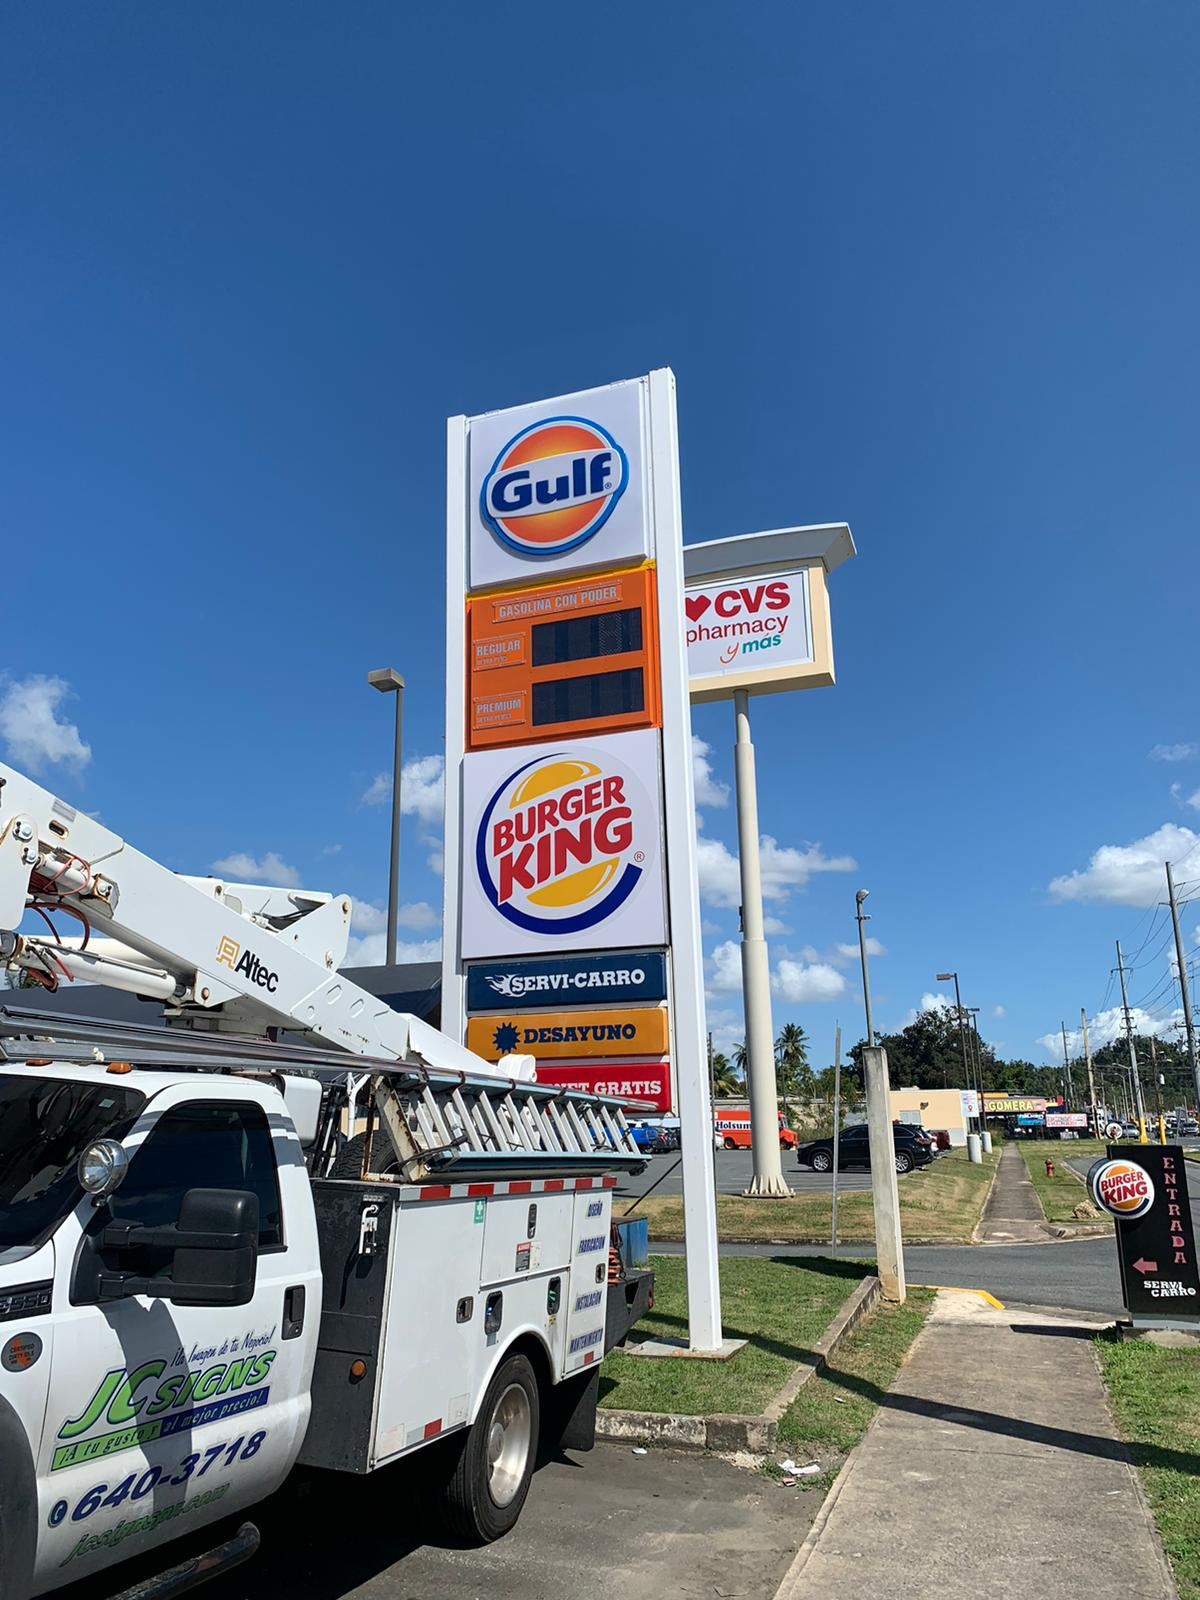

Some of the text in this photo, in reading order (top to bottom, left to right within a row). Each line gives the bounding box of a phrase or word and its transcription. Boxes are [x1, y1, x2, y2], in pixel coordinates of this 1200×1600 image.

[491, 452, 612, 512] Gulf
[499, 586, 617, 617] GASOLINA CON PODER
[714, 581, 791, 618] CVS
[686, 615, 789, 647] pharmacy
[476, 639, 521, 656] REGULAR
[719, 633, 782, 664] y más
[476, 699, 521, 713] PREMIUM
[493, 775, 626, 858] BURGER
[498, 806, 633, 905] KING
[234, 949, 279, 993] Altec
[512, 968, 646, 994] SERVI-CARRO
[523, 1023, 637, 1044] DESAYUNO
[594, 1080, 662, 1096] GRATIS
[988, 1100, 1034, 1111] GOMERA
[715, 1121, 753, 1130] Holsum
[1101, 1171, 1144, 1192] BURGER
[1103, 1181, 1148, 1206] KING
[1162, 1157, 1188, 1264] ENTRADA
[1144, 1280, 1183, 1289] SERVI
[1151, 1287, 1197, 1298] CARRO
[83, 1438, 97, 1454] tu
[102, 1427, 145, 1454] gusto
[180, 1406, 217, 1429] mejor
[71, 1430, 267, 1522] 640-3718
